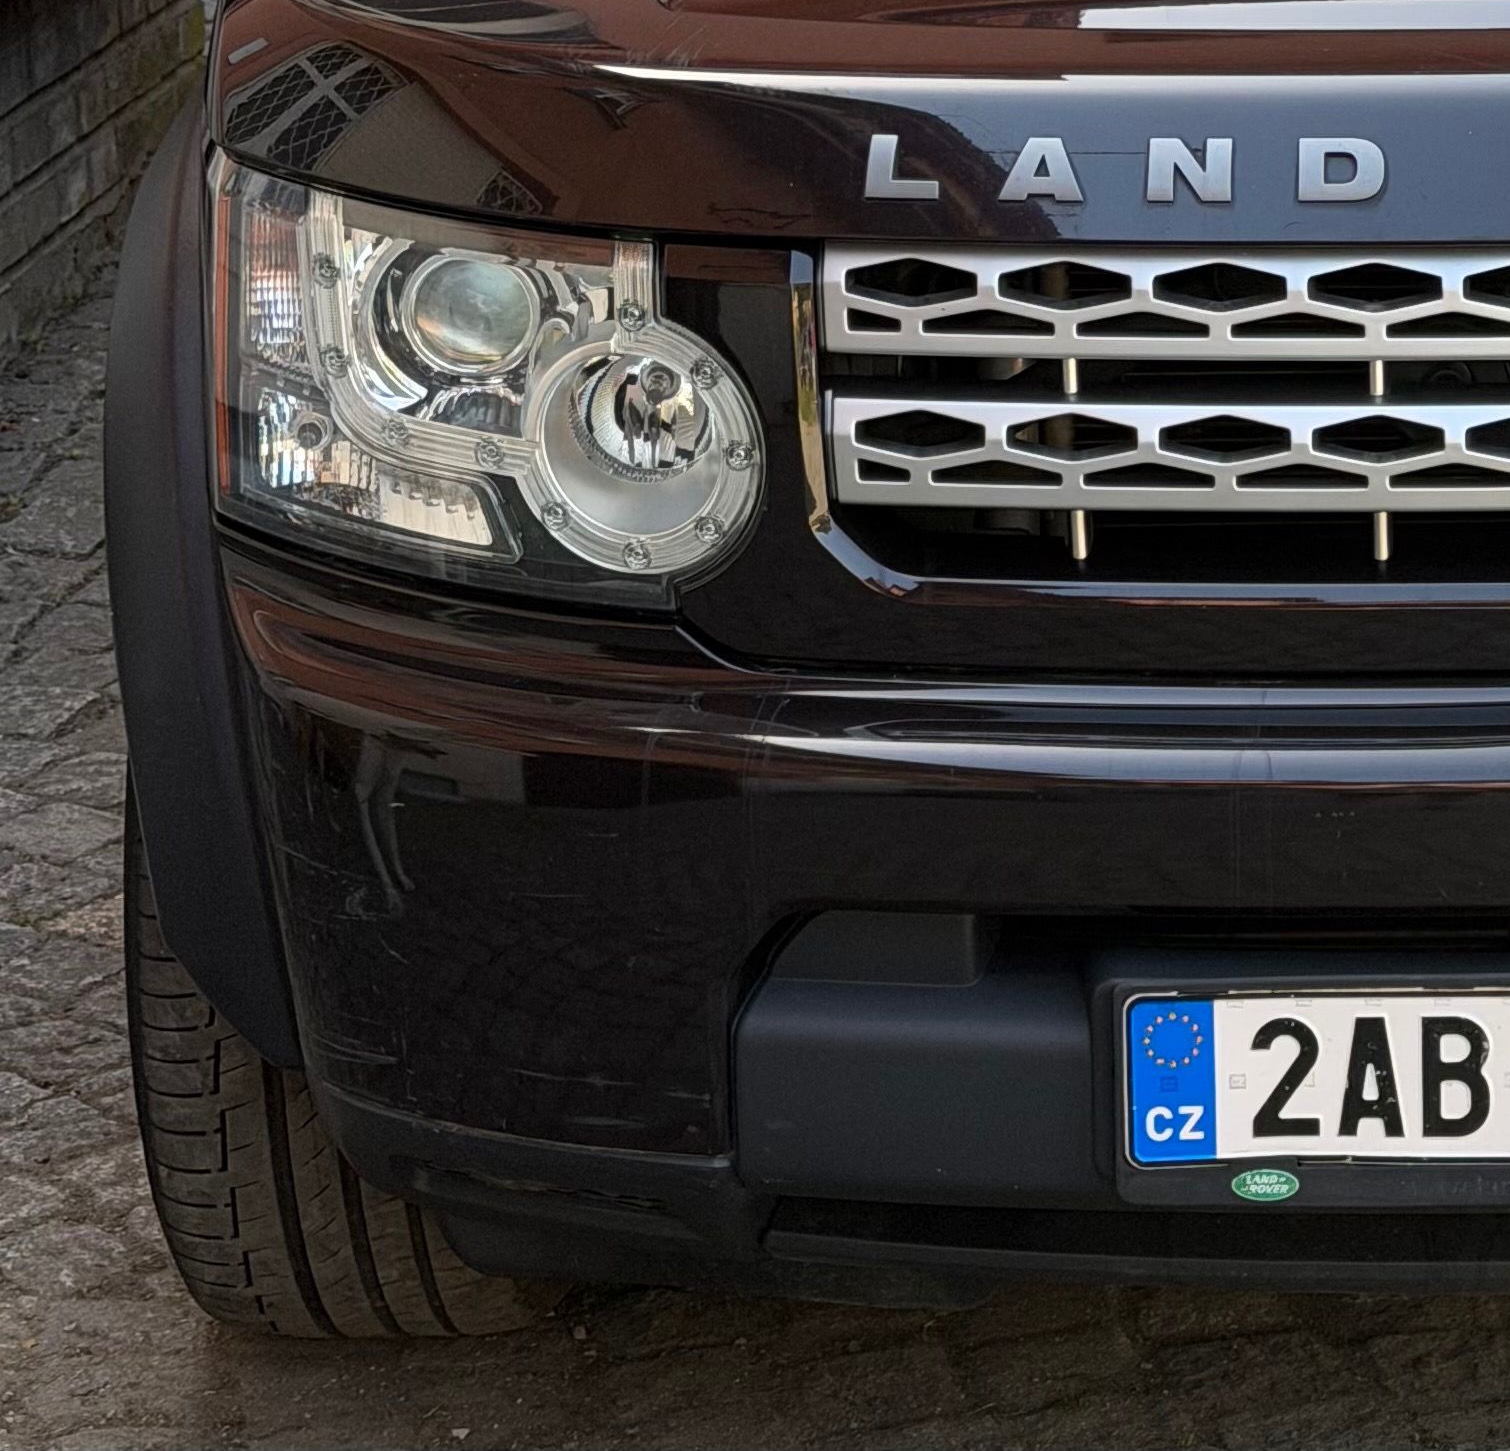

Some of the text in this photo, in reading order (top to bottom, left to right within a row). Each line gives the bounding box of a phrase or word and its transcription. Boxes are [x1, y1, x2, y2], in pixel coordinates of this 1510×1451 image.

[864, 133, 1385, 203] LAND
[1250, 1016, 1491, 1138] 2AB
[1145, 1105, 1205, 1142] CZ
[1245, 1174, 1279, 1185] LAND
[1249, 1183, 1290, 1195] ROVER
